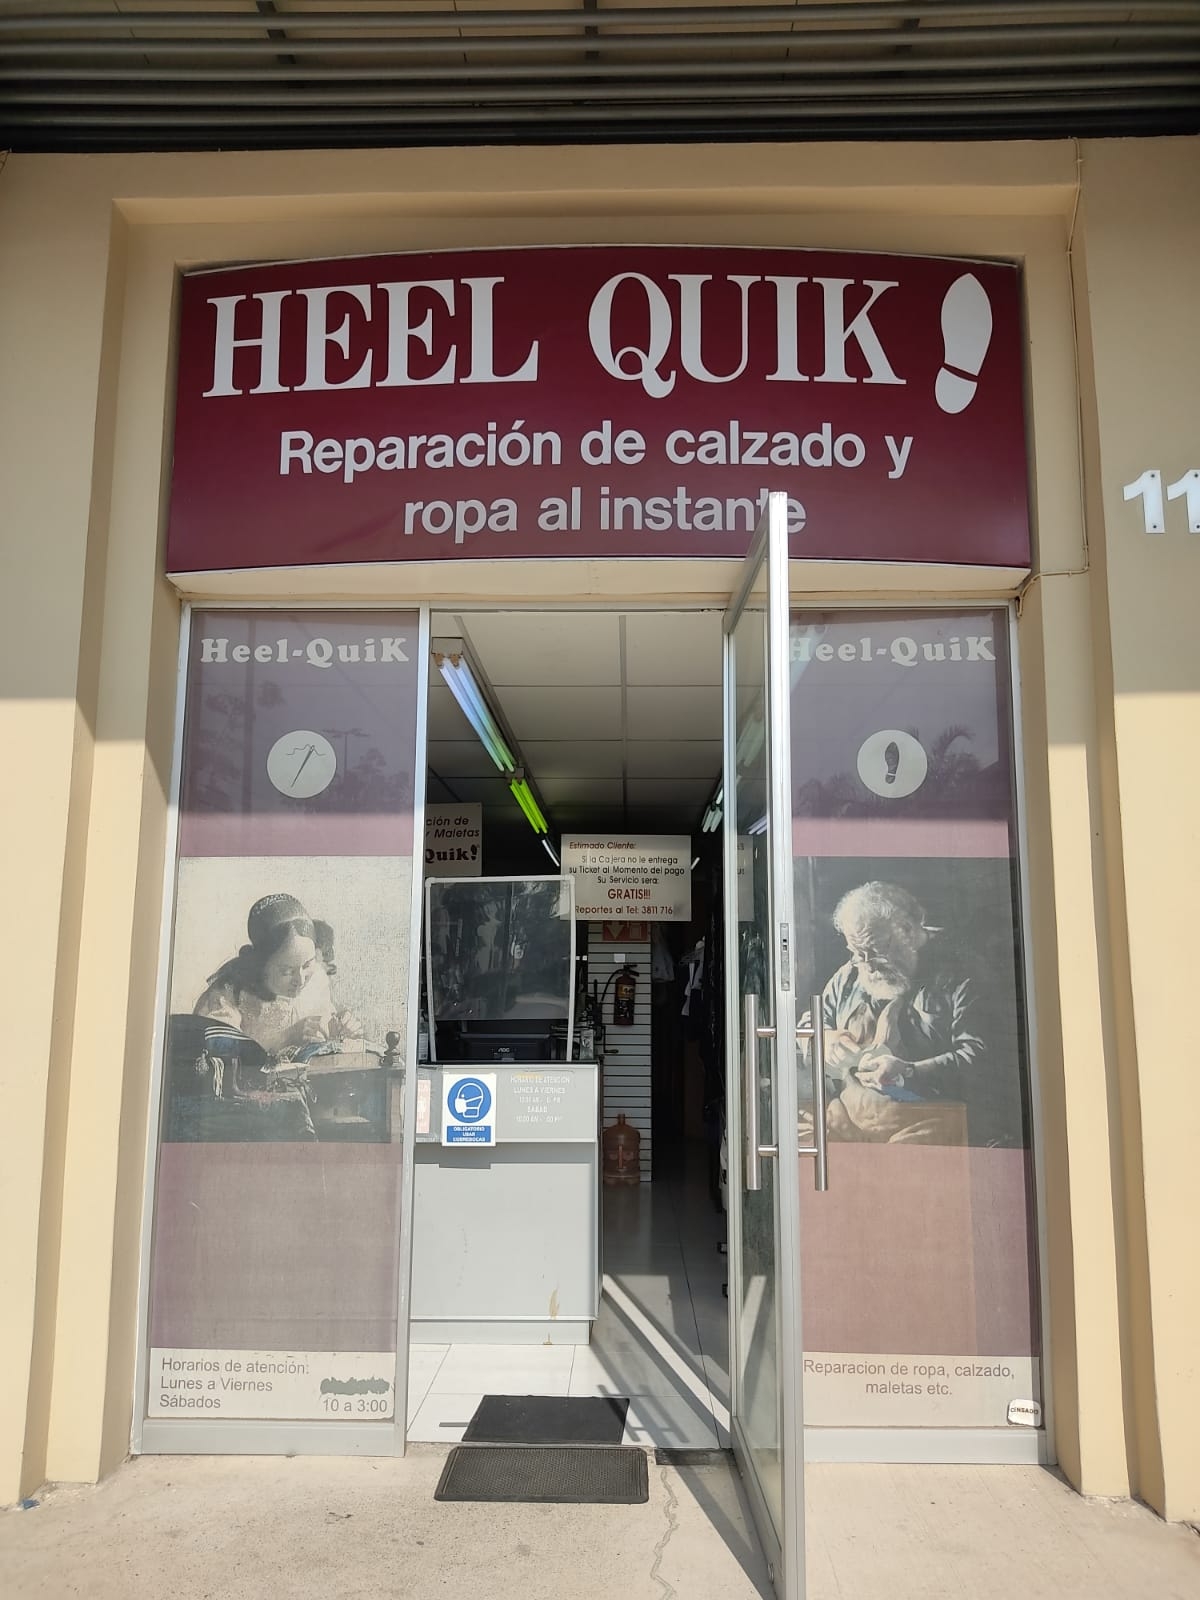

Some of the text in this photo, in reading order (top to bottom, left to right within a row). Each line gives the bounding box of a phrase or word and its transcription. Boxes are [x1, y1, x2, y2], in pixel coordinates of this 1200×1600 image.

[203, 272, 907, 398] HEEL QUIK
[280, 420, 914, 482] Reparación de calzado y
[404, 497, 519, 544] ropa
[538, 486, 581, 531] al
[200, 637, 410, 668] Heel-QuiK
[454, 815, 469, 826] de
[434, 828, 480, 838] Maletas
[569, 841, 605, 849] Estimado
[589, 855, 597, 864] la
[639, 855, 646, 864] le
[648, 856, 678, 866] entrega
[612, 866, 648, 874] Momento
[650, 866, 662, 874] del
[664, 867, 685, 876] pago
[597, 875, 606, 884] Su
[609, 875, 640, 884] Servicio
[607, 888, 651, 900] GRATIS!!!
[615, 905, 624, 914] al
[162, 1357, 310, 1375] Horarios de atención:
[803, 1359, 1015, 1379] Reparacion de ropa, calzado,
[160, 1376, 273, 1391] Lunes a Viernes
[865, 1381, 953, 1395] maletas etc.
[159, 1394, 388, 1413] Sábados 10 a 3:00
